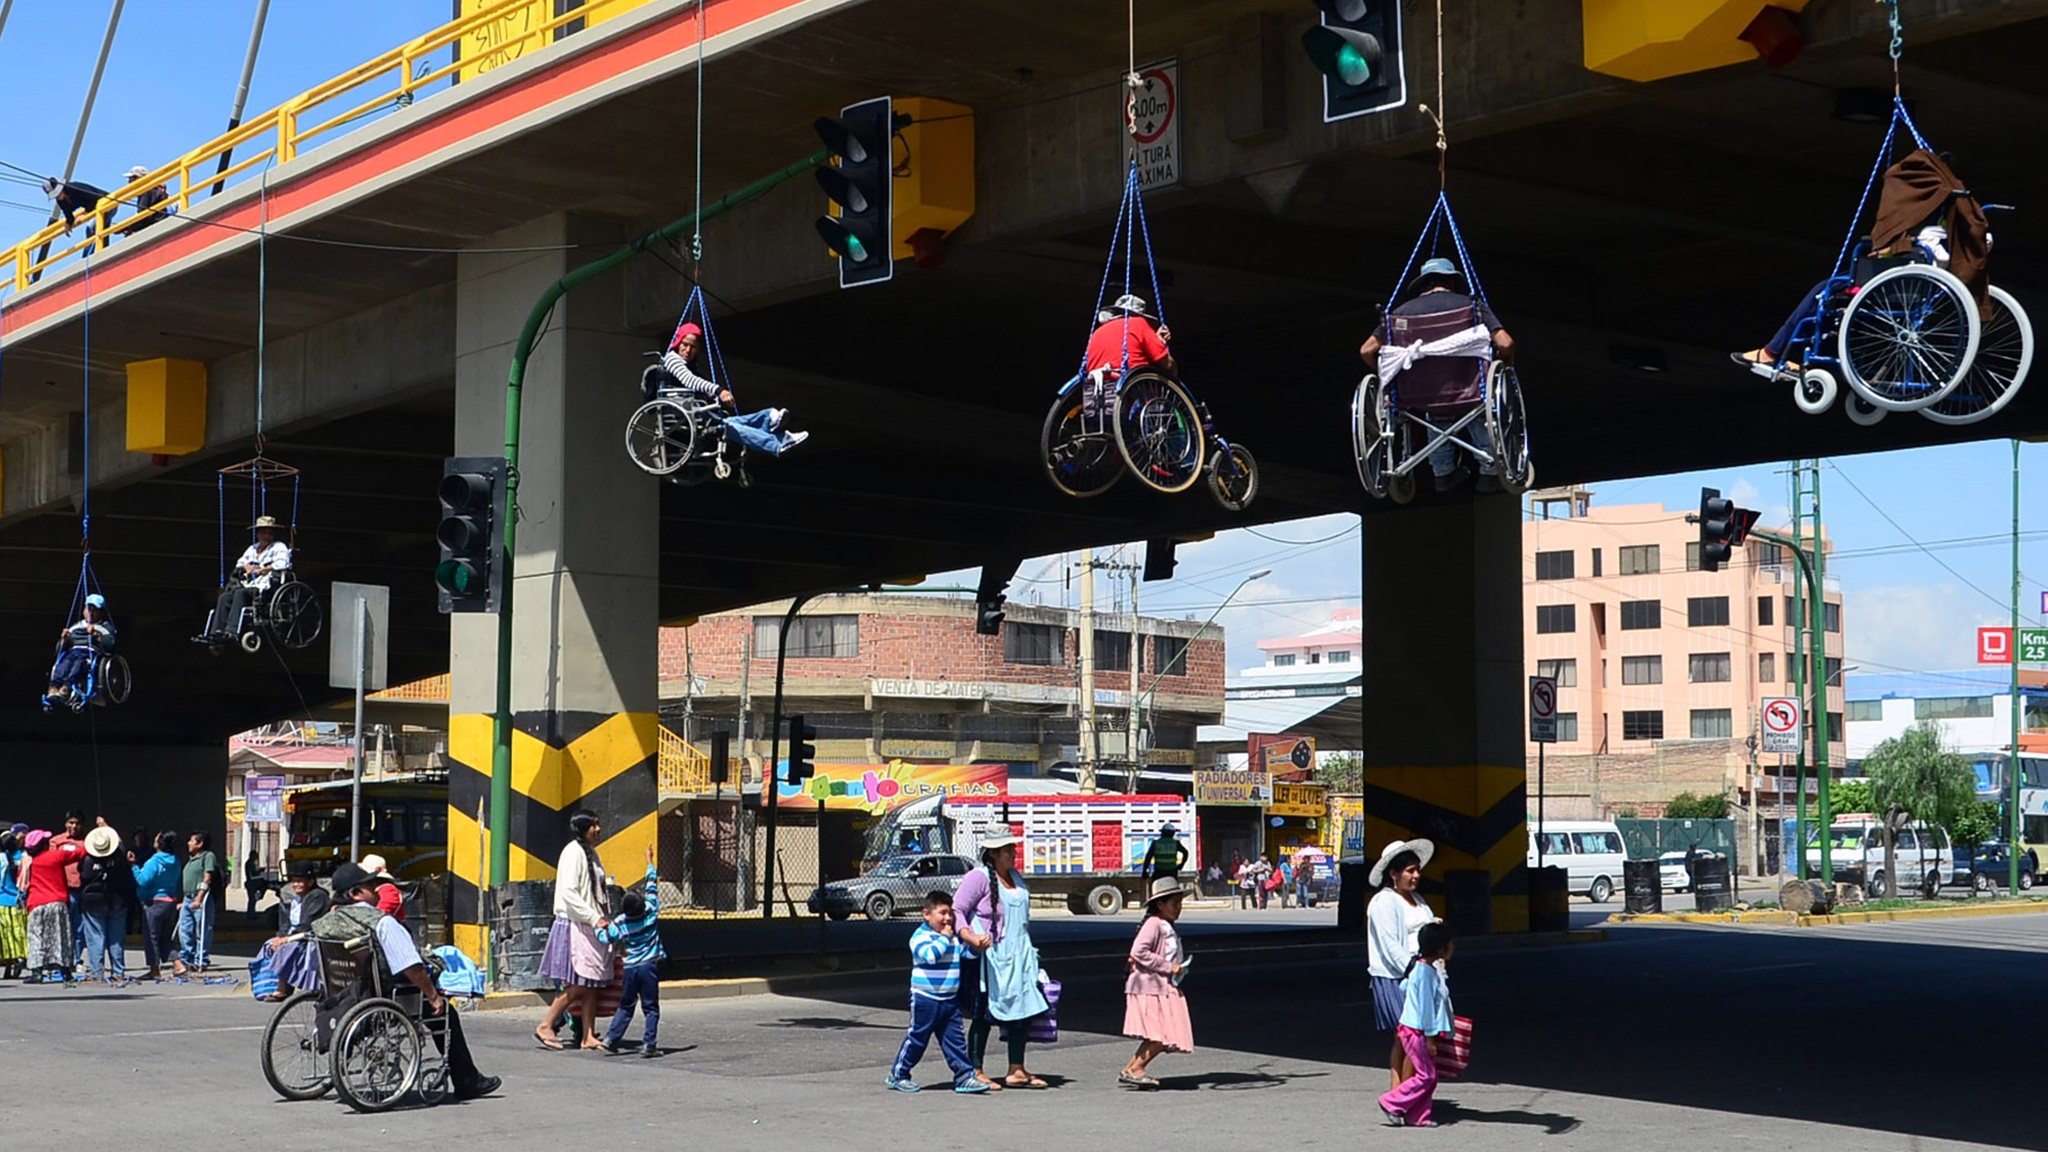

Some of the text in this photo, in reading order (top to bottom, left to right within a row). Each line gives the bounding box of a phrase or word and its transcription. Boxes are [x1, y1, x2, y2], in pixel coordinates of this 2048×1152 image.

[1134, 144, 1171, 168] LTURA
[1134, 164, 1173, 187] AXIMA
[876, 681, 918, 696] VENTA
[924, 682, 941, 696] DE
[1197, 771, 1267, 786] RADIADORES
[1207, 786, 1248, 801] UNIVERSAL
